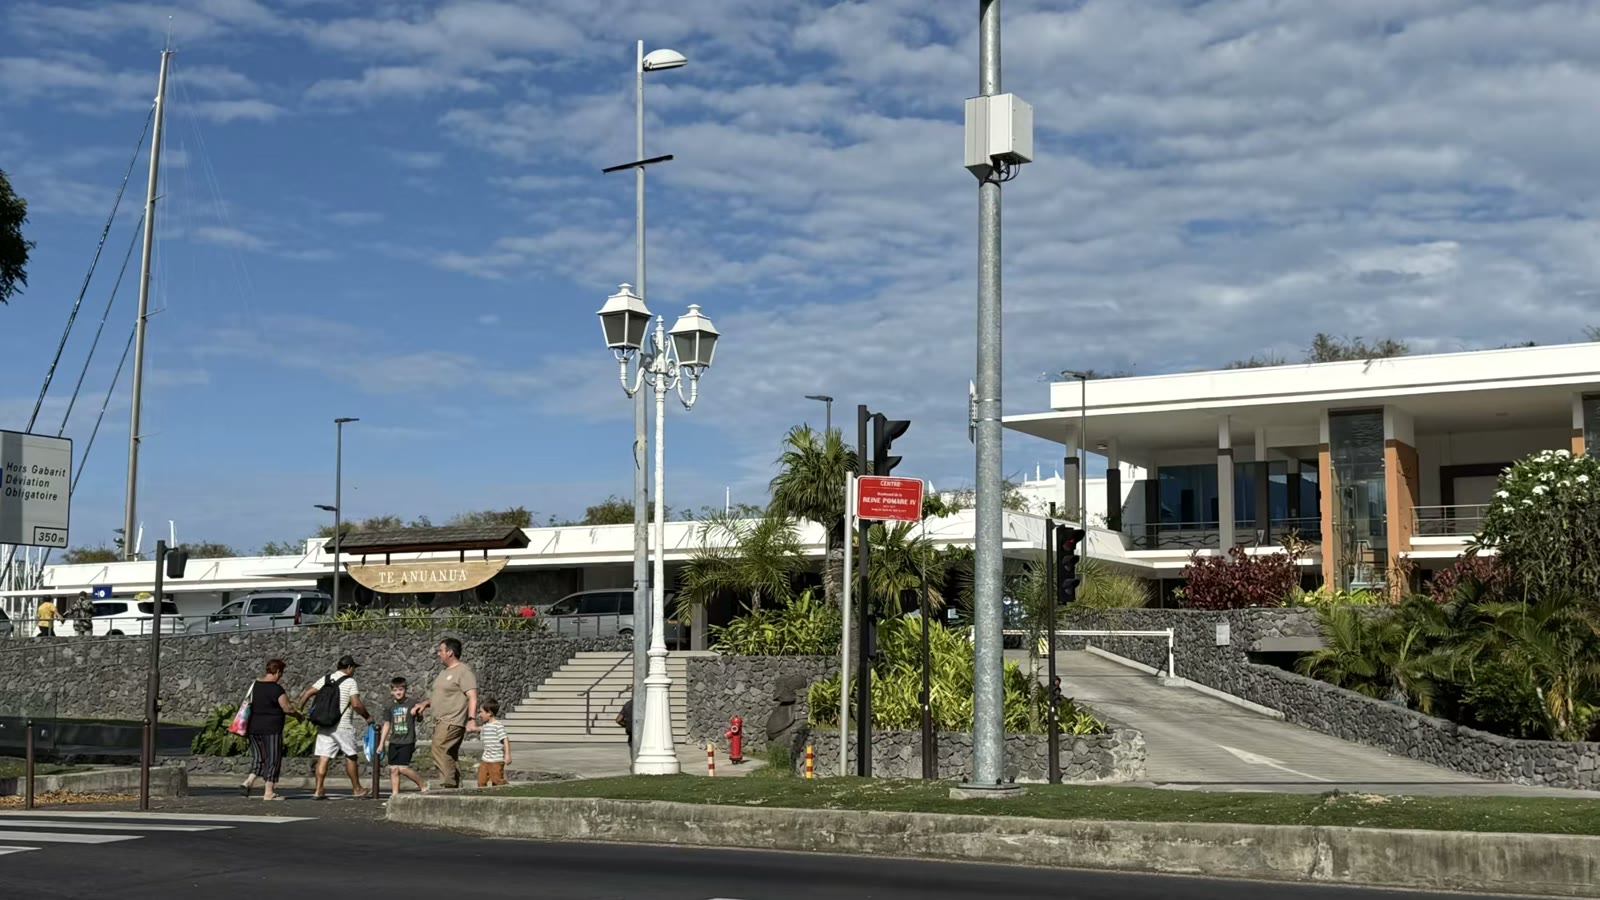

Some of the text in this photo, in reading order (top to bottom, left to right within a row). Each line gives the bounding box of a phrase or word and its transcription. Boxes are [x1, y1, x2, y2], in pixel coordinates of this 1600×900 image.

[6, 462, 67, 477] Hors Gabarit
[5, 474, 50, 488] Déviation
[5, 487, 58, 501] Obligatoire
[882, 497, 908, 505] POMARE
[38, 532, 58, 543] 350
[379, 569, 467, 584] TE ANUANUA
